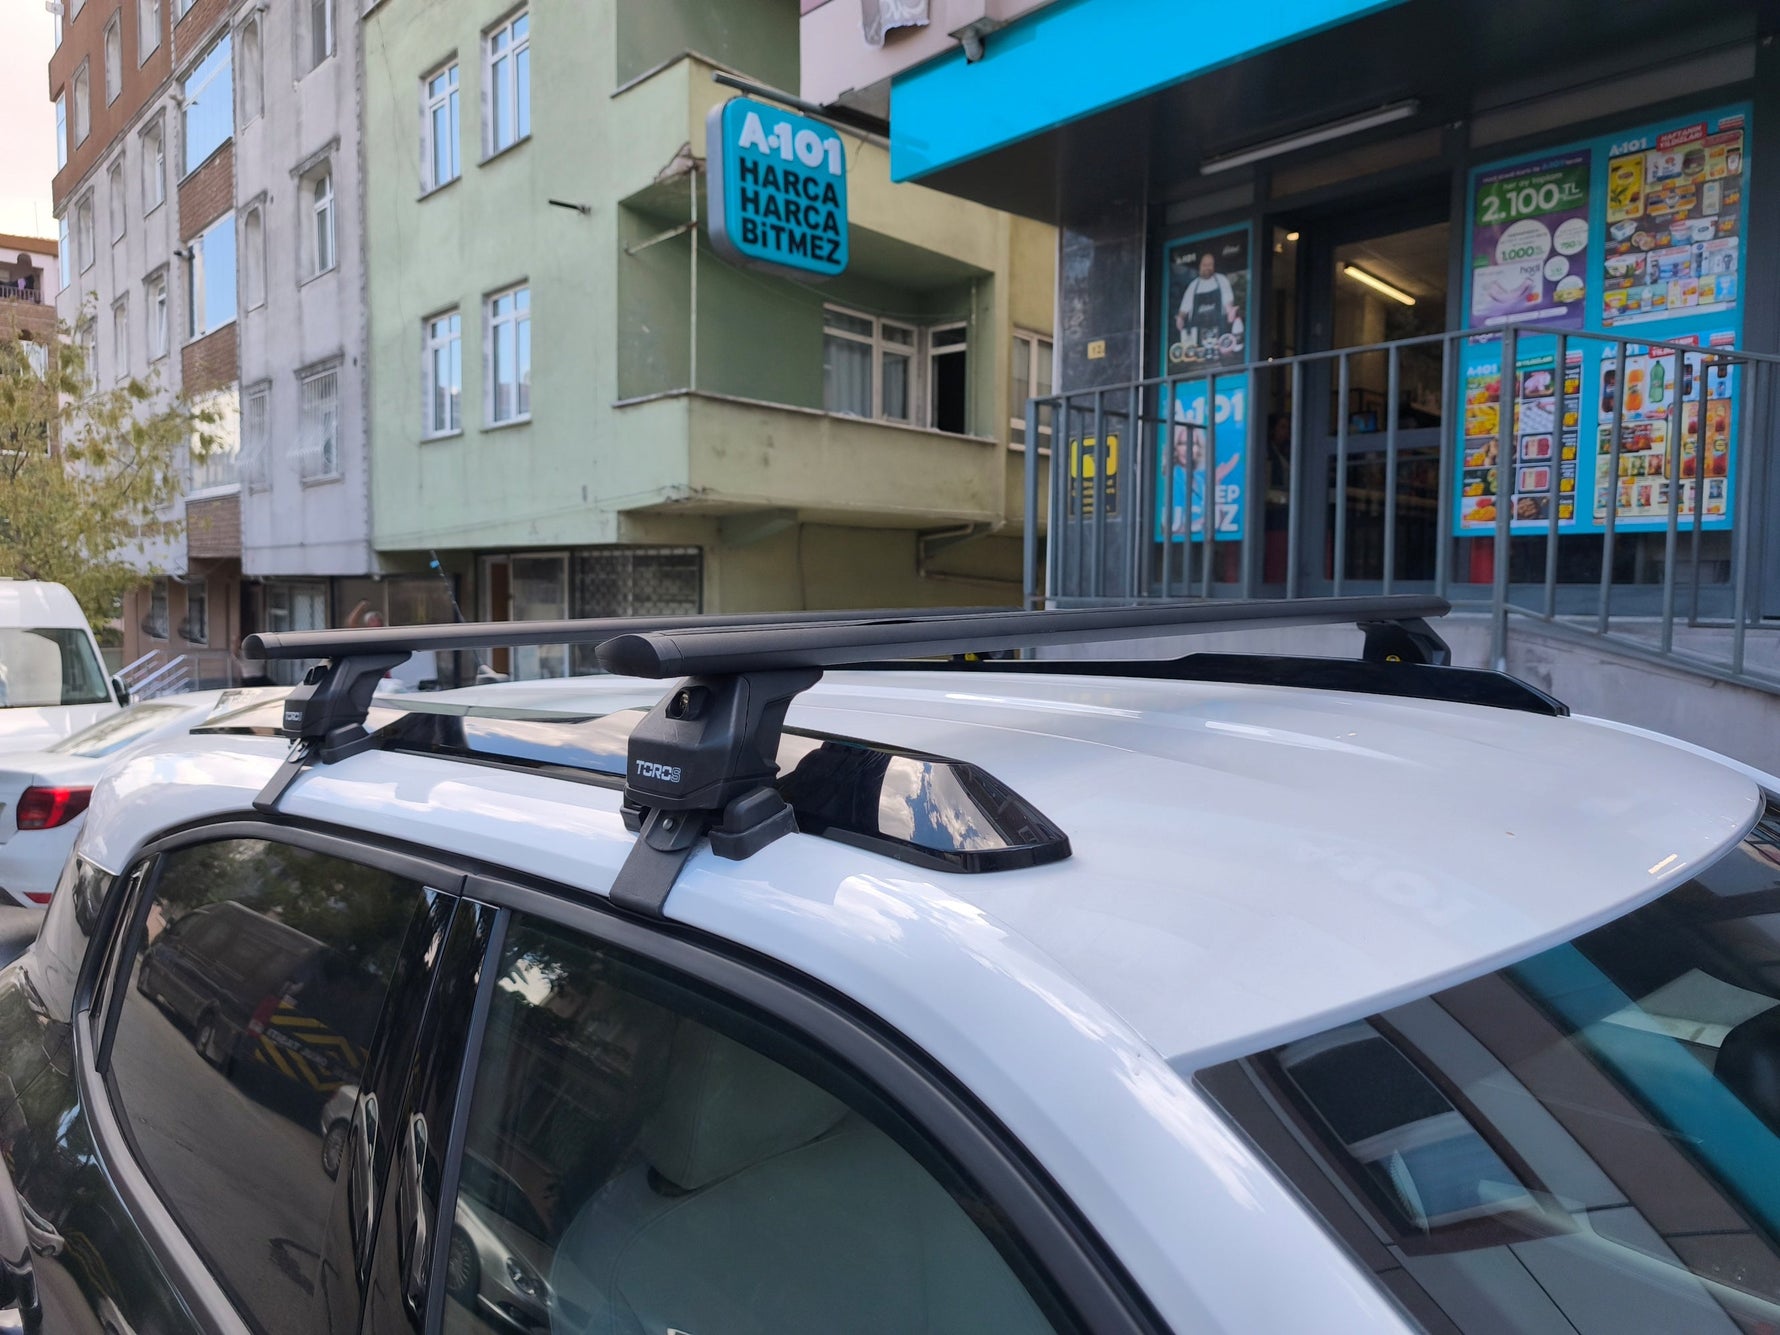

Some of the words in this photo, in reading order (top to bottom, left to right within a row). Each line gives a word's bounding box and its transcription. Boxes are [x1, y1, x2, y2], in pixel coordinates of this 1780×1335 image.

[740, 156, 840, 208] HARCA
[1482, 183, 1560, 222] 2.100
[740, 187, 840, 236] HARCA
[636, 759, 681, 783] TOROS
